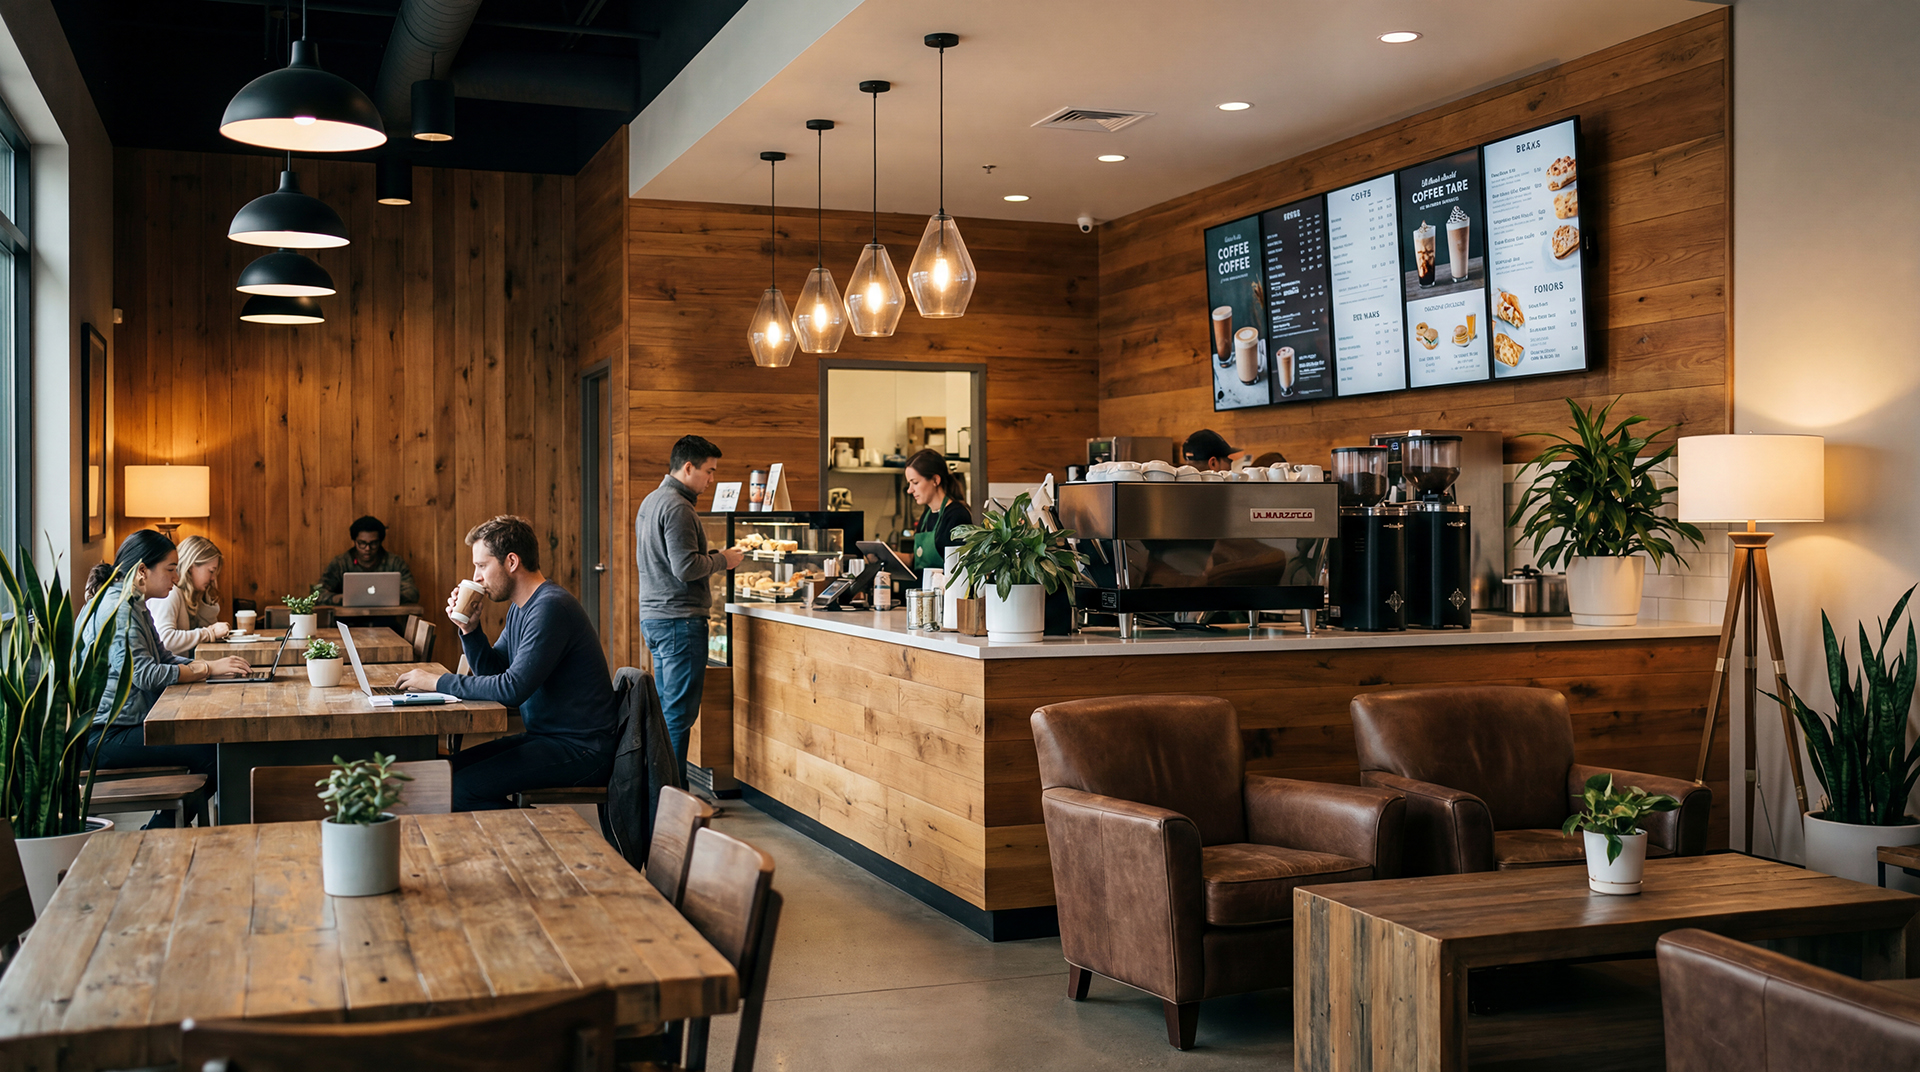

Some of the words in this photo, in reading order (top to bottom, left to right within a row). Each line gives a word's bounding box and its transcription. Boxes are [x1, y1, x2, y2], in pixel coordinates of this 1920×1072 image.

[1412, 185, 1444, 204] COFFEE
[1445, 179, 1469, 195] TARE
[1217, 241, 1250, 260] COFFEE
[1218, 256, 1251, 275] COFFEE
